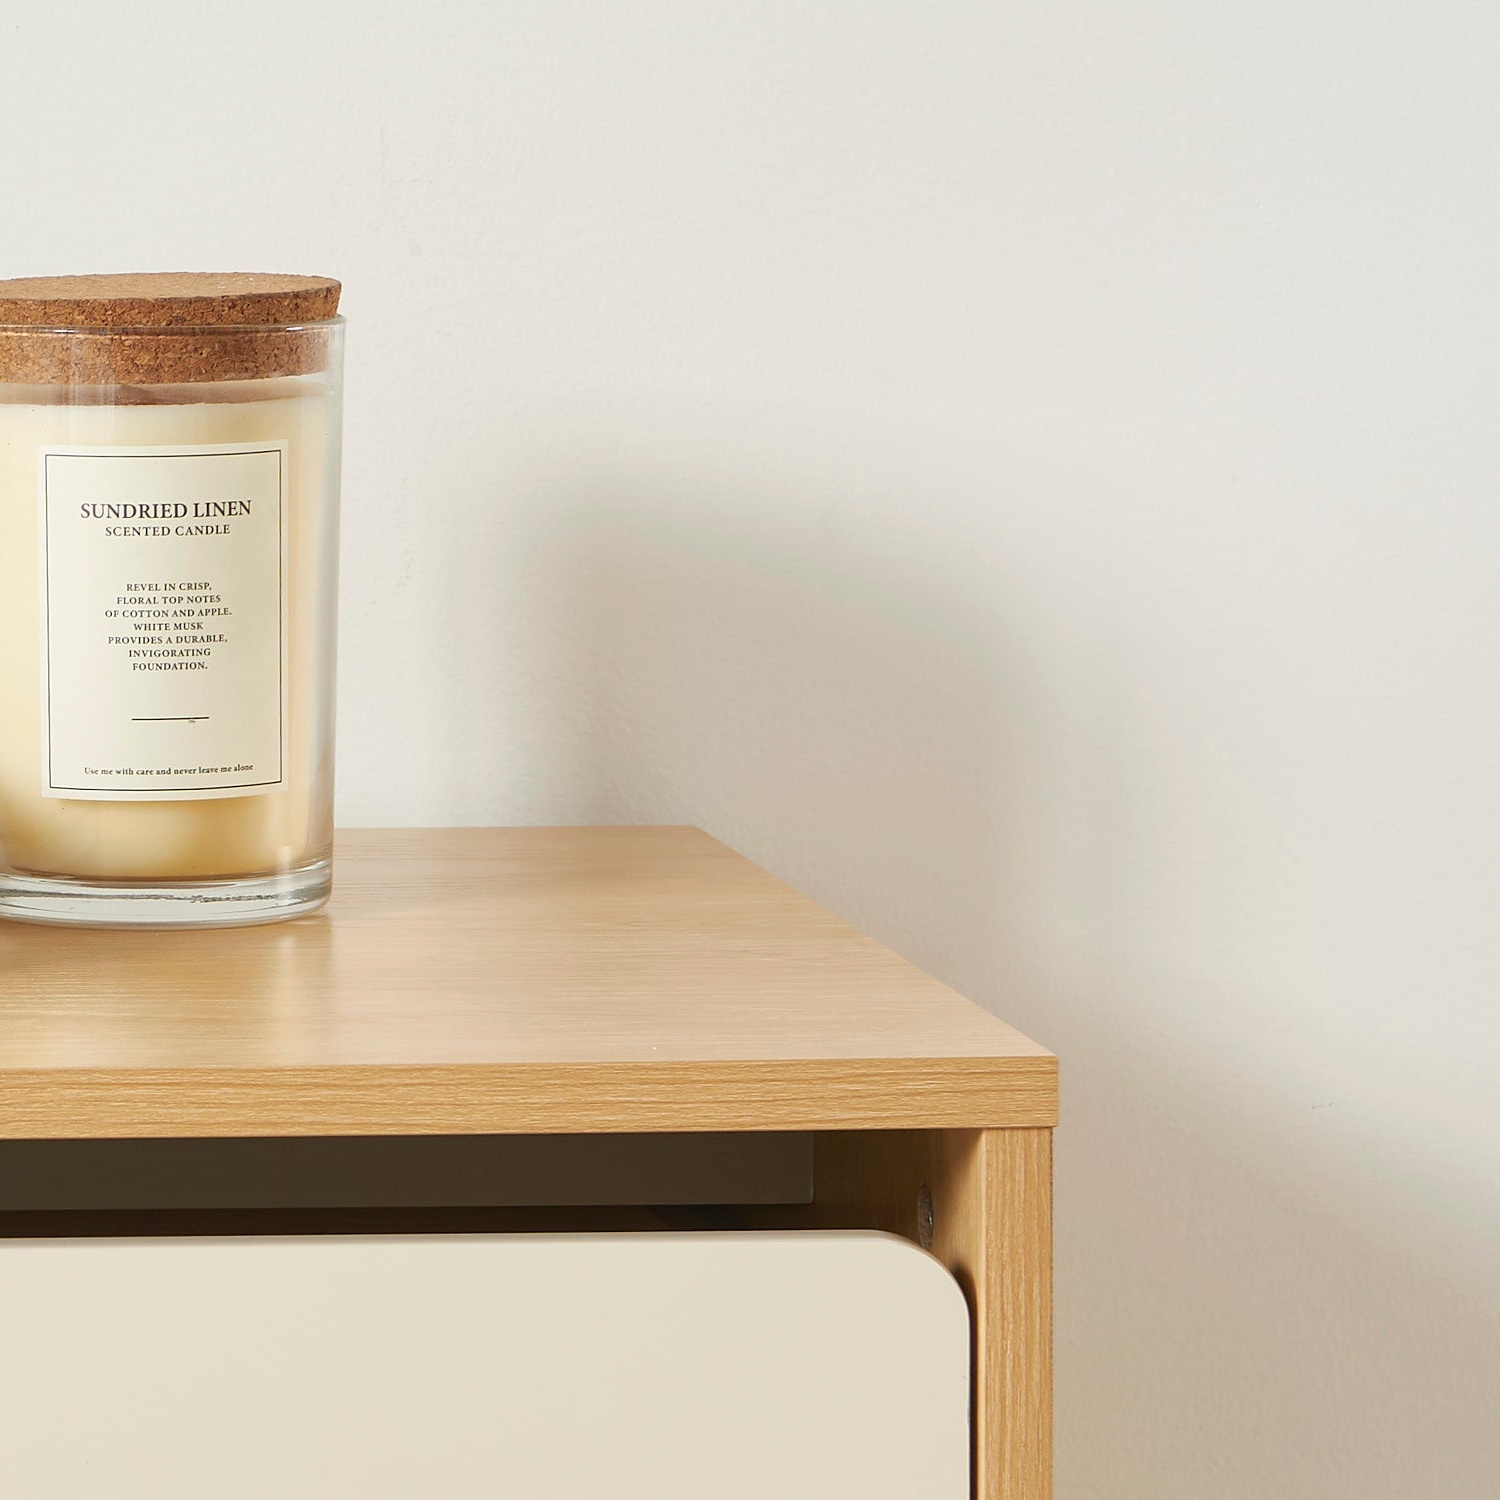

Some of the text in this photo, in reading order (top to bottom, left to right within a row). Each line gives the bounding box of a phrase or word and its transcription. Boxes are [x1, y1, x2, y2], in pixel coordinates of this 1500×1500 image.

[81, 499, 252, 519] SUNDRIED LINEN
[105, 524, 231, 537] SCENTED CANDLE
[126, 583, 161, 592] REVEL
[164, 582, 176, 591] IN
[117, 594, 221, 605] FLORAL TOP NOTES
[104, 609, 119, 618] OF
[122, 609, 169, 618] COTTON
[171, 609, 195, 618] AND
[133, 621, 204, 632] WHITE MUSK
[108, 636, 163, 645] PROVIDES
[165, 636, 173, 644] A
[128, 647, 211, 658] INVIGORATING
[84, 767, 99, 775] Use
[115, 767, 134, 775] with
[155, 767, 172, 775] and
[198, 766, 219, 774] leave
[233, 763, 254, 772] alone
